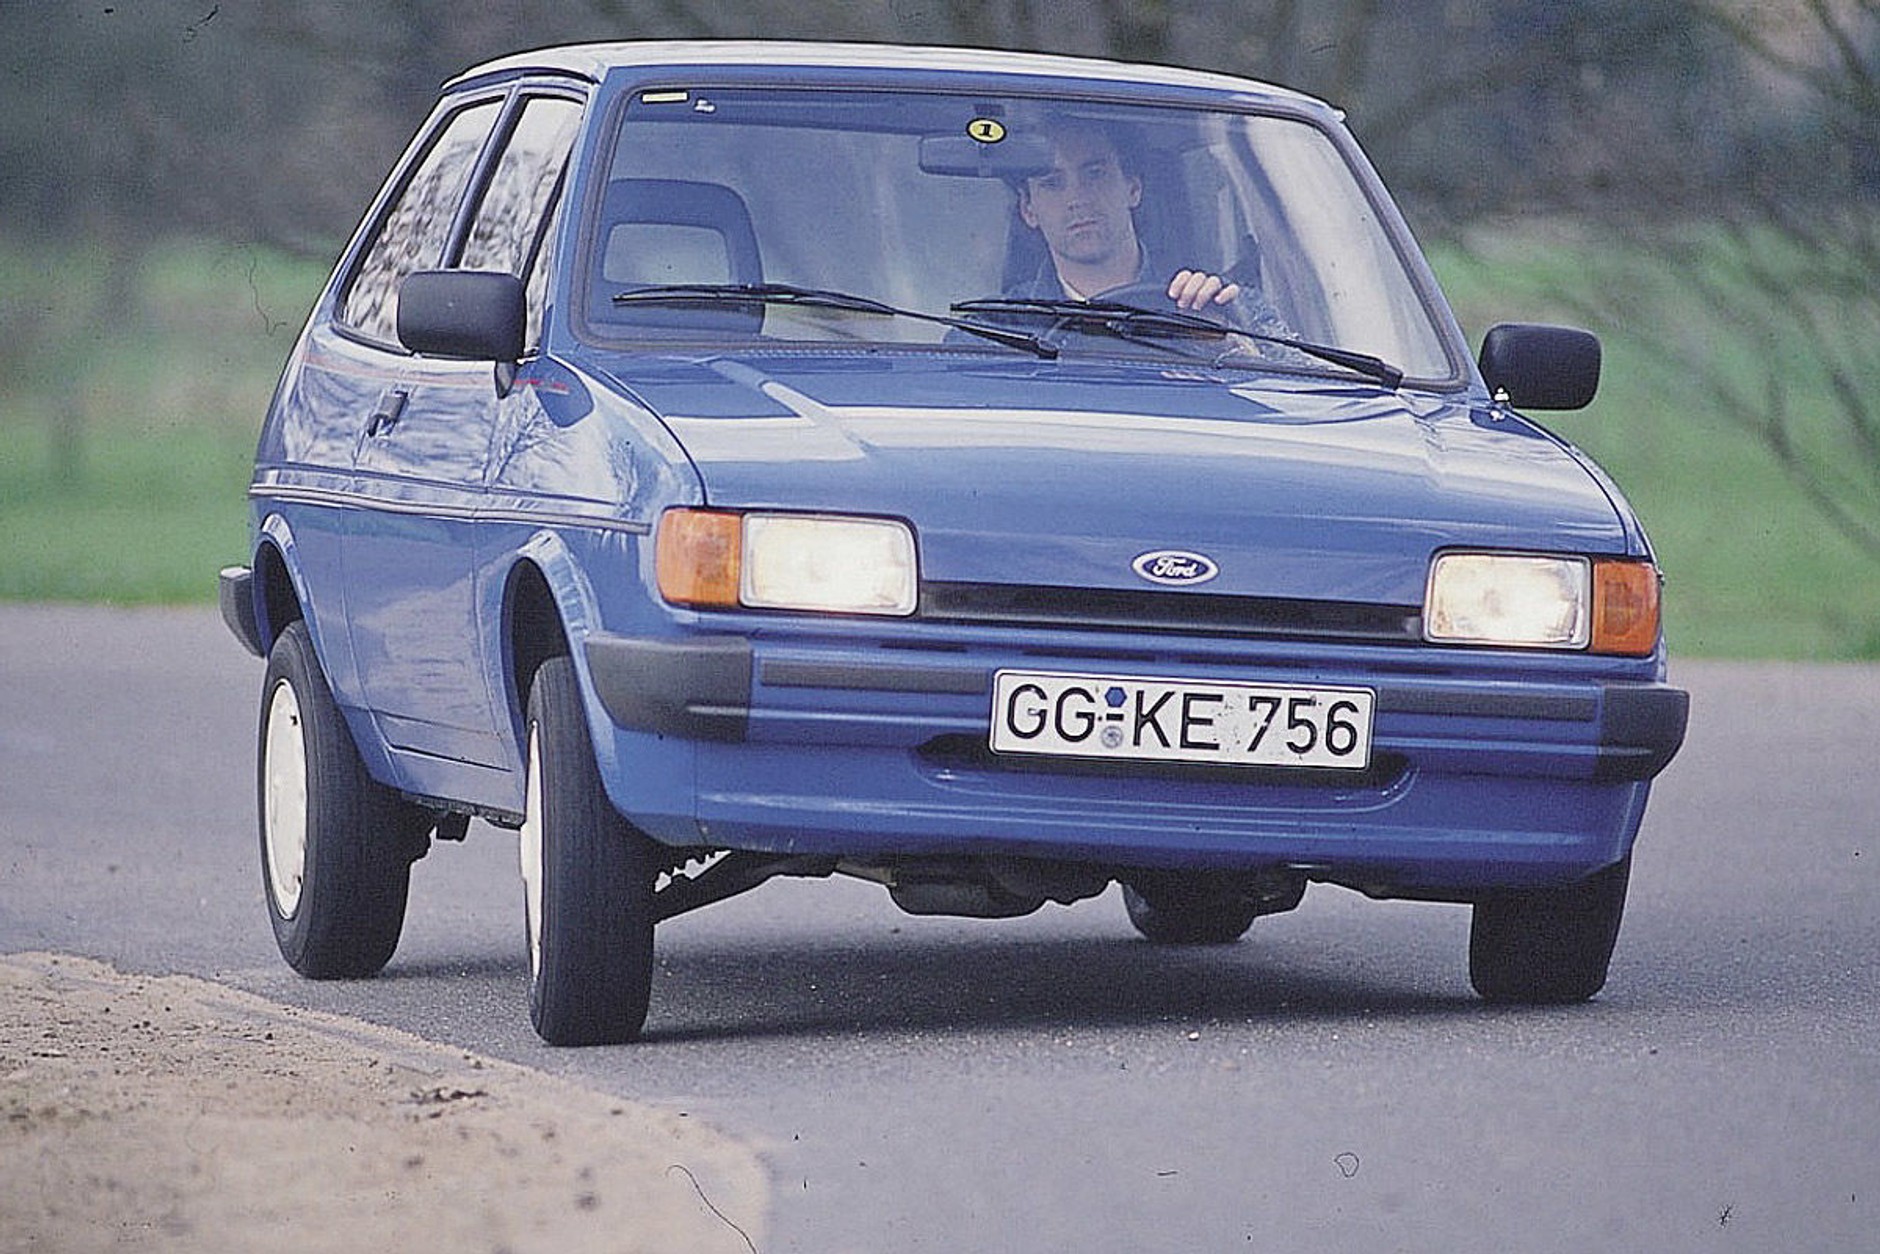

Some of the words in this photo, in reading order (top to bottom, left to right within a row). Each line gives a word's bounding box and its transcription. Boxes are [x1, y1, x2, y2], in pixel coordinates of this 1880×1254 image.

[977, 124, 993, 138] 1
[1152, 556, 1198, 577] Ford
[1247, 696, 1359, 756] 756
